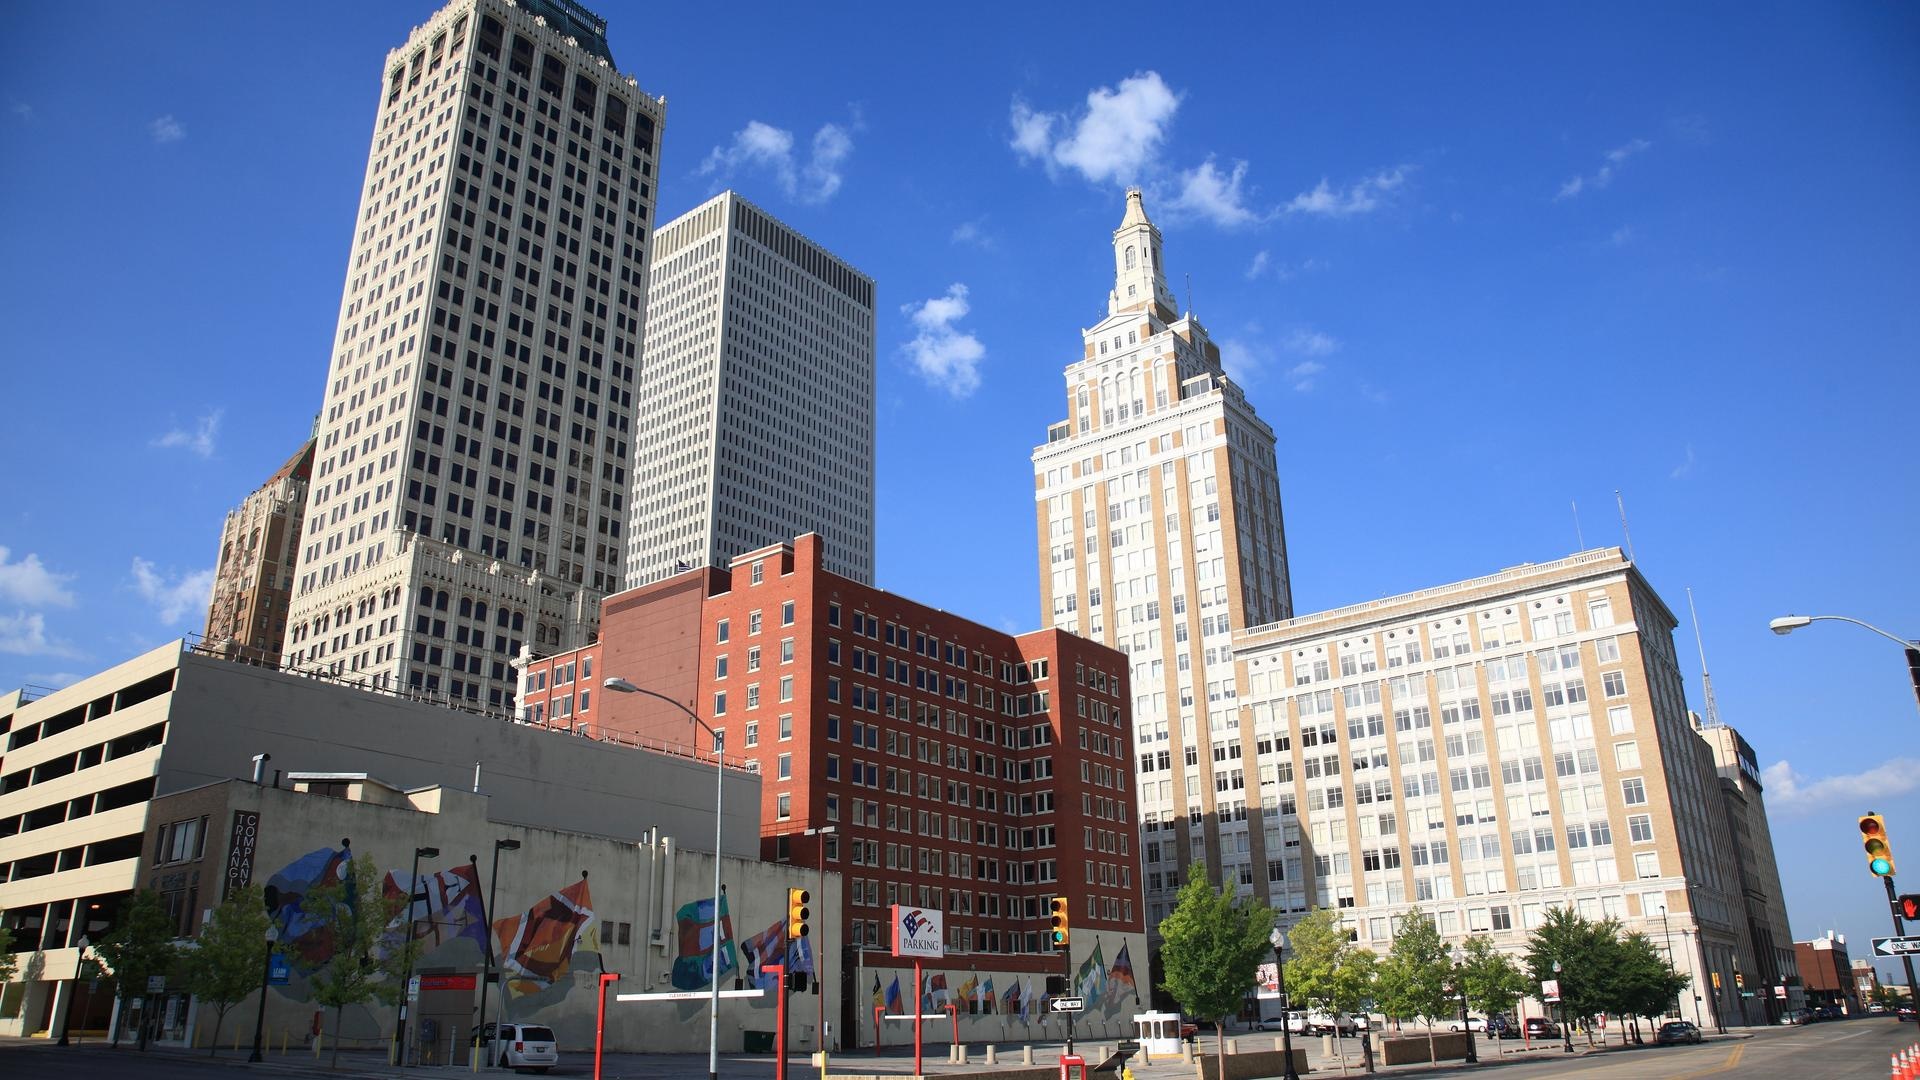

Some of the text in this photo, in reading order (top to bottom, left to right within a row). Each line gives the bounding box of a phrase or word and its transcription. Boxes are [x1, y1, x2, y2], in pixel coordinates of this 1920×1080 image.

[240, 815, 257, 889] COMPANY
[903, 938, 939, 951] PARKING
[1911, 941, 1920, 949] WA
